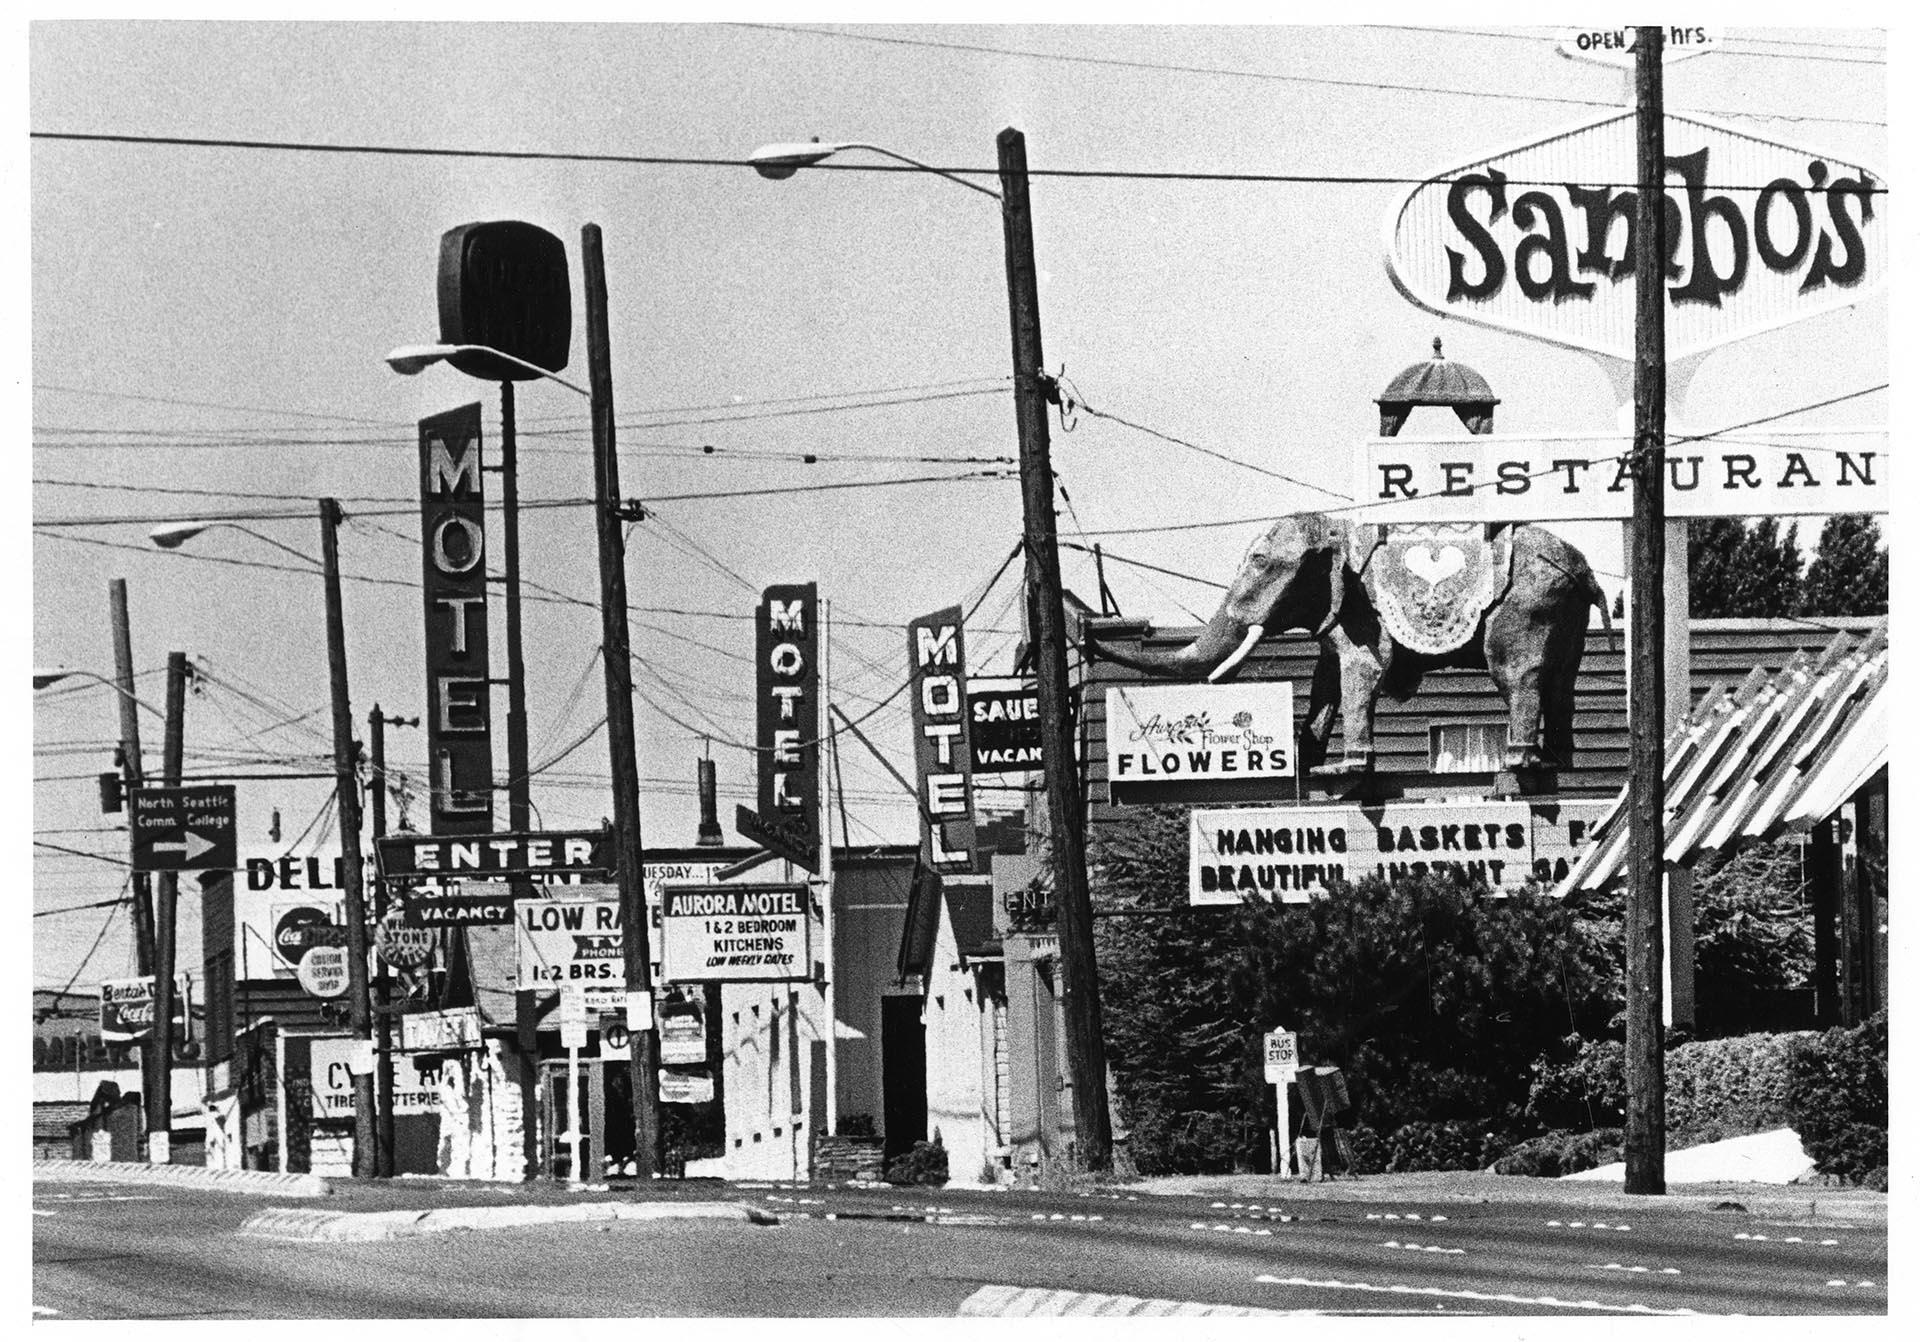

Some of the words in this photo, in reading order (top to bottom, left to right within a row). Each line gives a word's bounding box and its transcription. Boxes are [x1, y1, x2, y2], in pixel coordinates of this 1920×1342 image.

[1576, 31, 1625, 51] OPEN
[1670, 25, 1713, 45] hrs.
[1444, 147, 1876, 309] Sambo's
[429, 437, 489, 812] MOTEL
[770, 599, 804, 807] MOTEL
[916, 625, 969, 863] MOTEL
[1201, 729, 1241, 749] Flower
[1242, 729, 1274, 750] Shop
[976, 746, 1044, 764] VACAN
[1117, 749, 1288, 775] FLOWERS
[137, 797, 175, 809] North
[181, 796, 229, 808] Seattle
[186, 813, 230, 829] College
[1217, 826, 1348, 856] HANGING
[1376, 823, 1526, 852] BASKETS
[414, 838, 593, 870] ENTER
[420, 905, 508, 920] VACANCY
[670, 893, 738, 916] AURORA
[740, 892, 802, 915] MOTEL
[527, 906, 584, 932] LOW
[737, 919, 797, 934] BEDROOM
[713, 936, 784, 953] KITCHENS
[706, 956, 726, 967] LOW
[763, 953, 795, 966] RATES
[569, 962, 617, 980] BRS.
[1270, 1039, 1292, 1049] BUS
[1268, 1050, 1294, 1061] STOP
